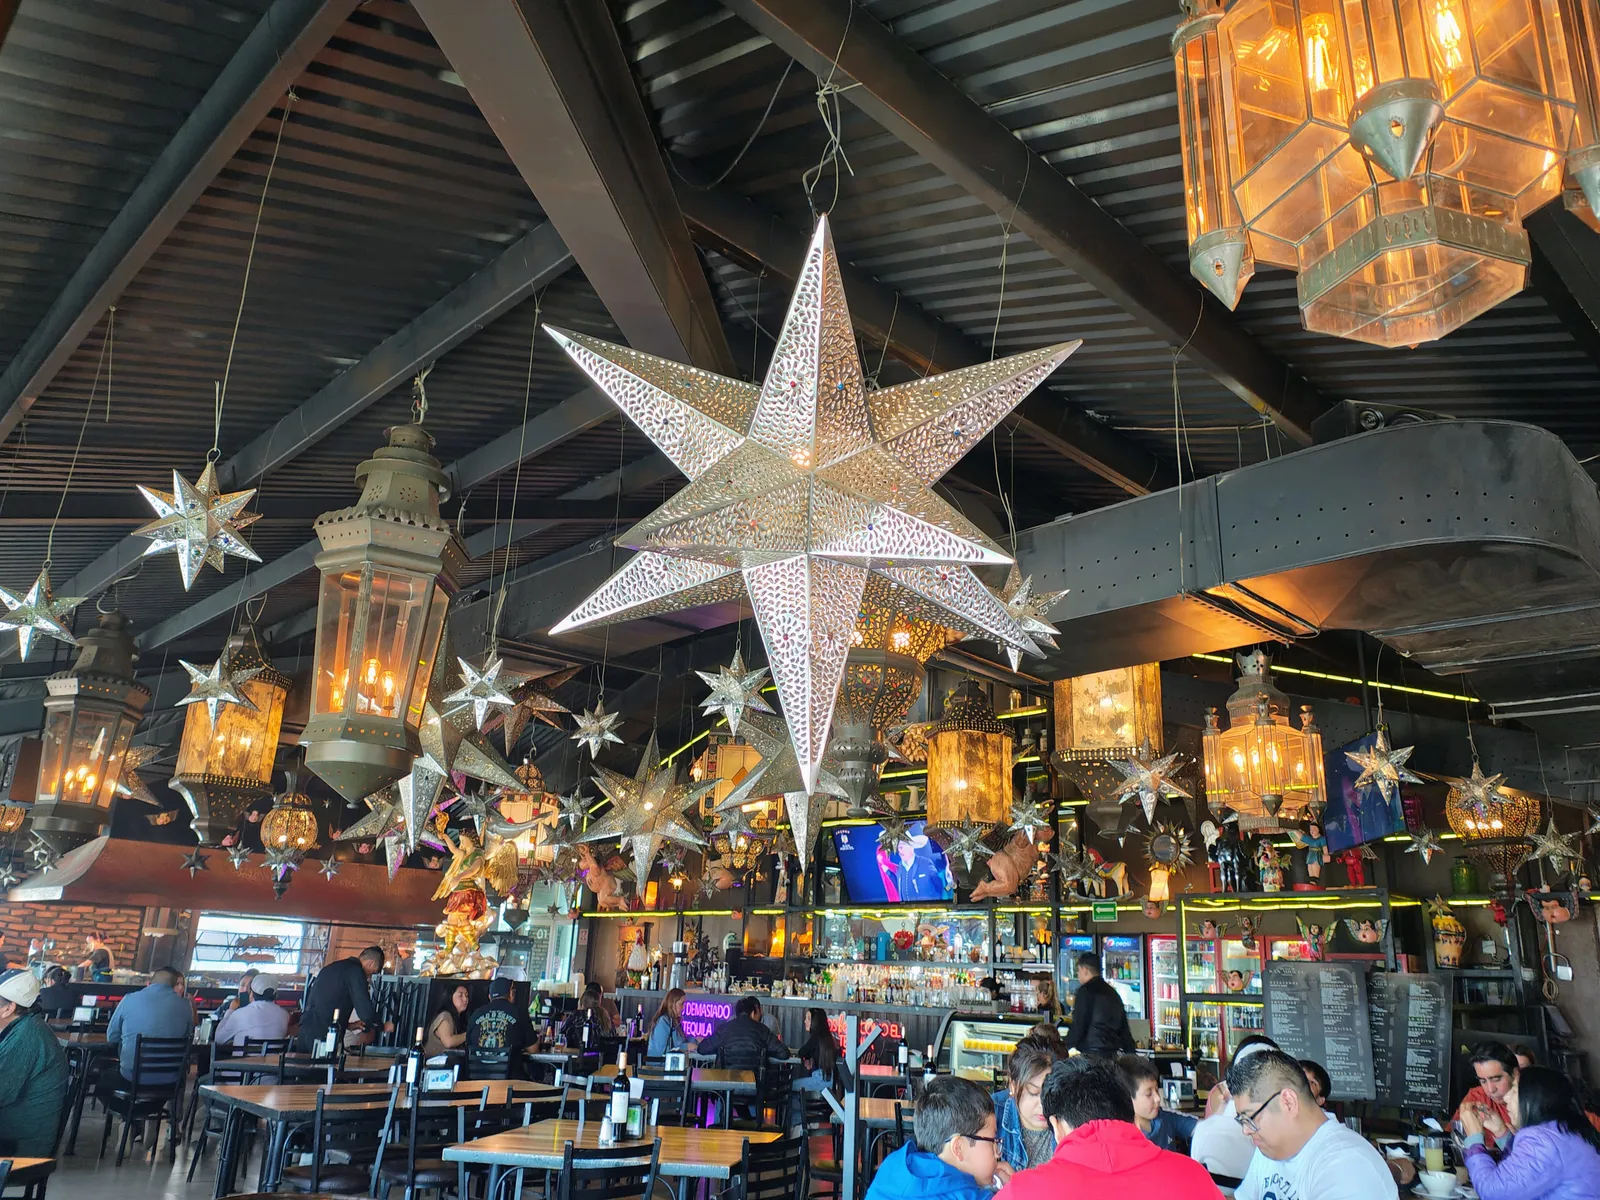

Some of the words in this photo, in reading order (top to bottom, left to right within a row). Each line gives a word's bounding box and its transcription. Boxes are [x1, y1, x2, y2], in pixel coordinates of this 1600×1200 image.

[537, 929, 548, 939] 01
[1073, 939, 1092, 948] pepsi
[497, 1011, 517, 1025] SILVER
[686, 1002, 731, 1020] DEMASIADO
[682, 1020, 712, 1037] TEQUILA
